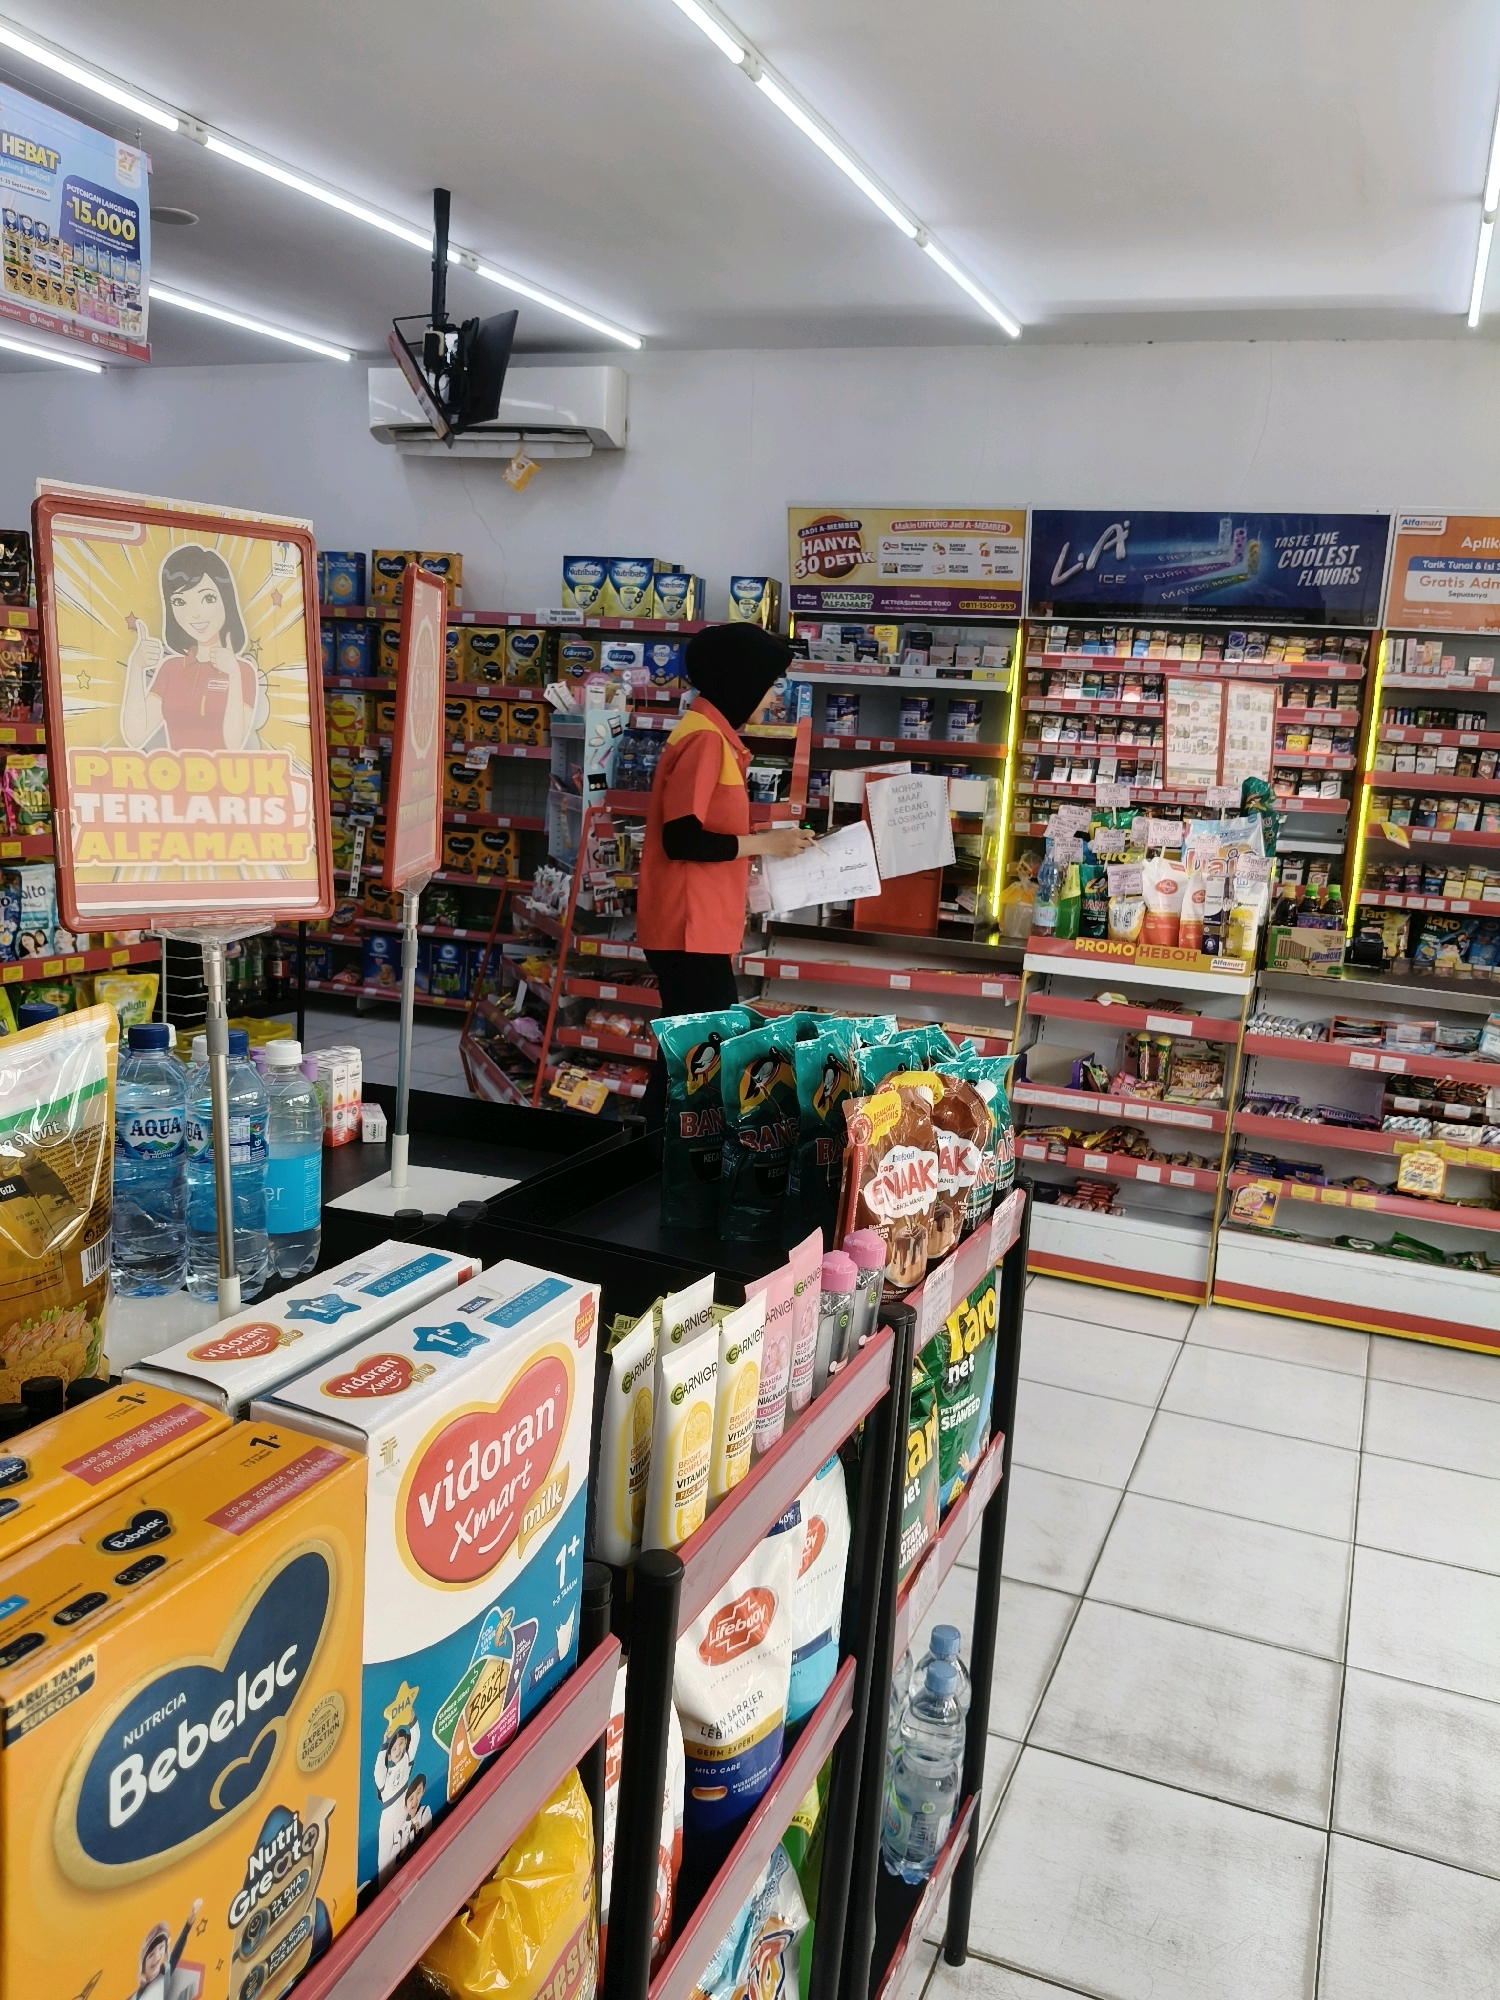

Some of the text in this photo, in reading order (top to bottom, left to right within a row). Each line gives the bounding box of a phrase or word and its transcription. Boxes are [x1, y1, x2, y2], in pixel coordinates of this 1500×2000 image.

[2, 132, 59, 170] HEBAT
[72, 196, 136, 241] 15.000
[101, 199, 136, 218] LANGSUNG
[819, 521, 859, 533] A-MEMBER
[916, 521, 948, 529] UNTUNG
[1401, 518, 1443, 527] Alfamart
[801, 537, 861, 557] HANYA
[1274, 531, 1340, 549] TASTE THE
[794, 552, 876, 579] 30 DETIK
[1277, 545, 1360, 569] COOLEST
[1422, 560, 1446, 569] Tarik
[1448, 561, 1473, 570] Tunai
[1098, 573, 1127, 585] ICE
[1143, 568, 1195, 581] PURPLE
[1297, 566, 1362, 587] FLAVORS
[1419, 575, 1465, 588] Gratis
[822, 592, 873, 601] WHATSAPP
[1161, 582, 1209, 600] MANGO
[1448, 590, 1488, 599] Sepuasnya
[822, 601, 872, 609] ALFAMART
[73, 755, 289, 797] PRODUK
[891, 781, 923, 795] MOHON
[898, 792, 921, 803] MAAF
[887, 810, 937, 827] CLOSINGAN
[893, 801, 929, 815] SEDANG
[902, 822, 926, 834] SHIFT
[77, 831, 308, 862] ALFAMART
[1360, 906, 1389, 920] Taro
[1425, 914, 1461, 930] Taro
[1074, 938, 1198, 963] PROMO HEBOH
[1212, 959, 1244, 968] Alfamart
[130, 1116, 182, 1138] AQUA
[879, 1164, 894, 1174] Cap
[670, 1305, 713, 1344] GARNIER
[947, 1288, 997, 1364] Taro
[202, 1325, 269, 1359] vidoran
[279, 1329, 301, 1346] milk
[427, 1328, 452, 1346] 1+
[725, 1324, 765, 1365] GARNIER
[336, 1356, 399, 1395] vidoran
[411, 1366, 433, 1382] milk
[947, 1353, 975, 1384] net
[366, 1369, 402, 1394] Xmart
[669, 1361, 718, 1406] GARNIER
[940, 1398, 981, 1432] SEAWEED
[418, 1397, 555, 1528] vidoran
[449, 1459, 533, 1563] Xmart
[523, 1481, 564, 1536] milk
[110, 1518, 164, 1549] Bebelac
[900, 1521, 922, 1555] OTATO
[555, 1535, 580, 1589] 1+
[709, 1603, 767, 1647] Lifebuoy
[52, 1653, 94, 1687] TANPA
[391, 1699, 412, 1720] DHA
[727, 1689, 764, 1724] BARRIER
[122, 1692, 188, 1750] NUTRICIA
[108, 1643, 298, 1829] Bebelac
[301, 1719, 340, 1761] DIGESTION
[302, 1717, 331, 1750] EXPERT
[697, 1734, 755, 1757] GERM EXPERT
[695, 1760, 741, 1775] MILD CARE
[249, 1812, 298, 1881] Nutri
